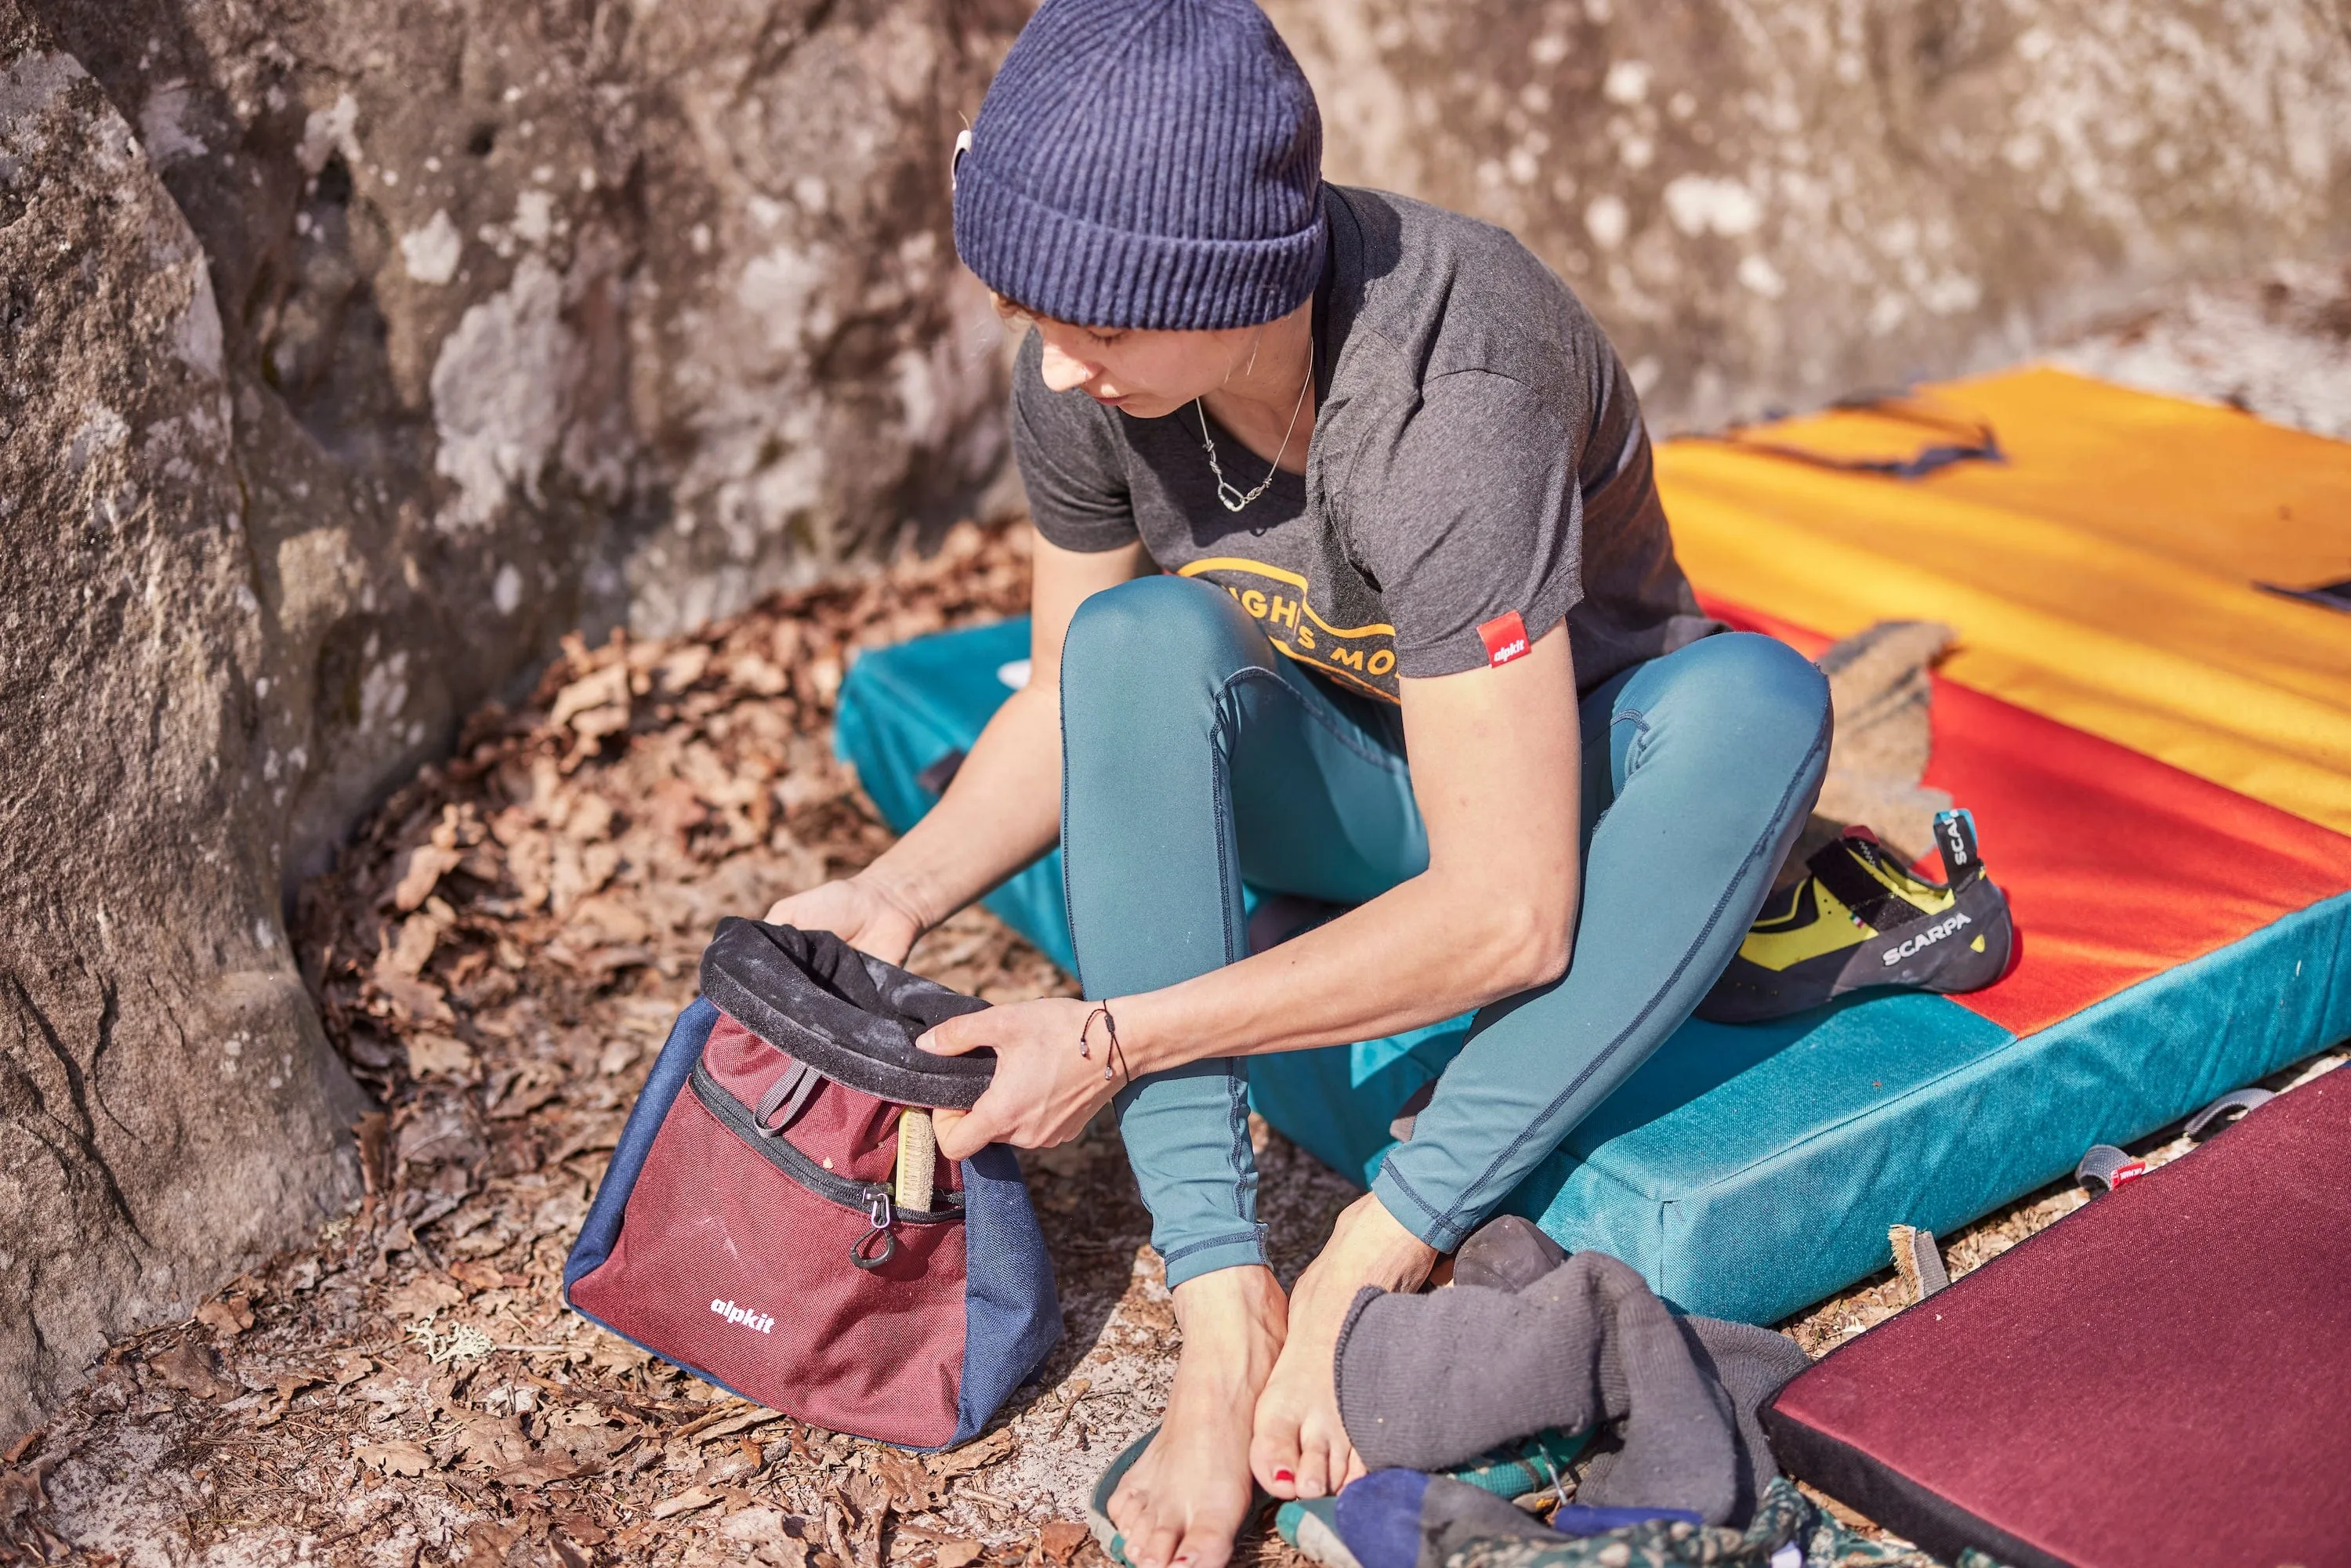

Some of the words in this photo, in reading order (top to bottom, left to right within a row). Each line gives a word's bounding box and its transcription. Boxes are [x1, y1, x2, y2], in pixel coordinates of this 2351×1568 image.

[1330, 647, 1400, 679] MO
[1494, 639, 1524, 661] alpkit
[1882, 912, 1972, 966] SCARPA
[711, 1298, 775, 1334] alpkit
